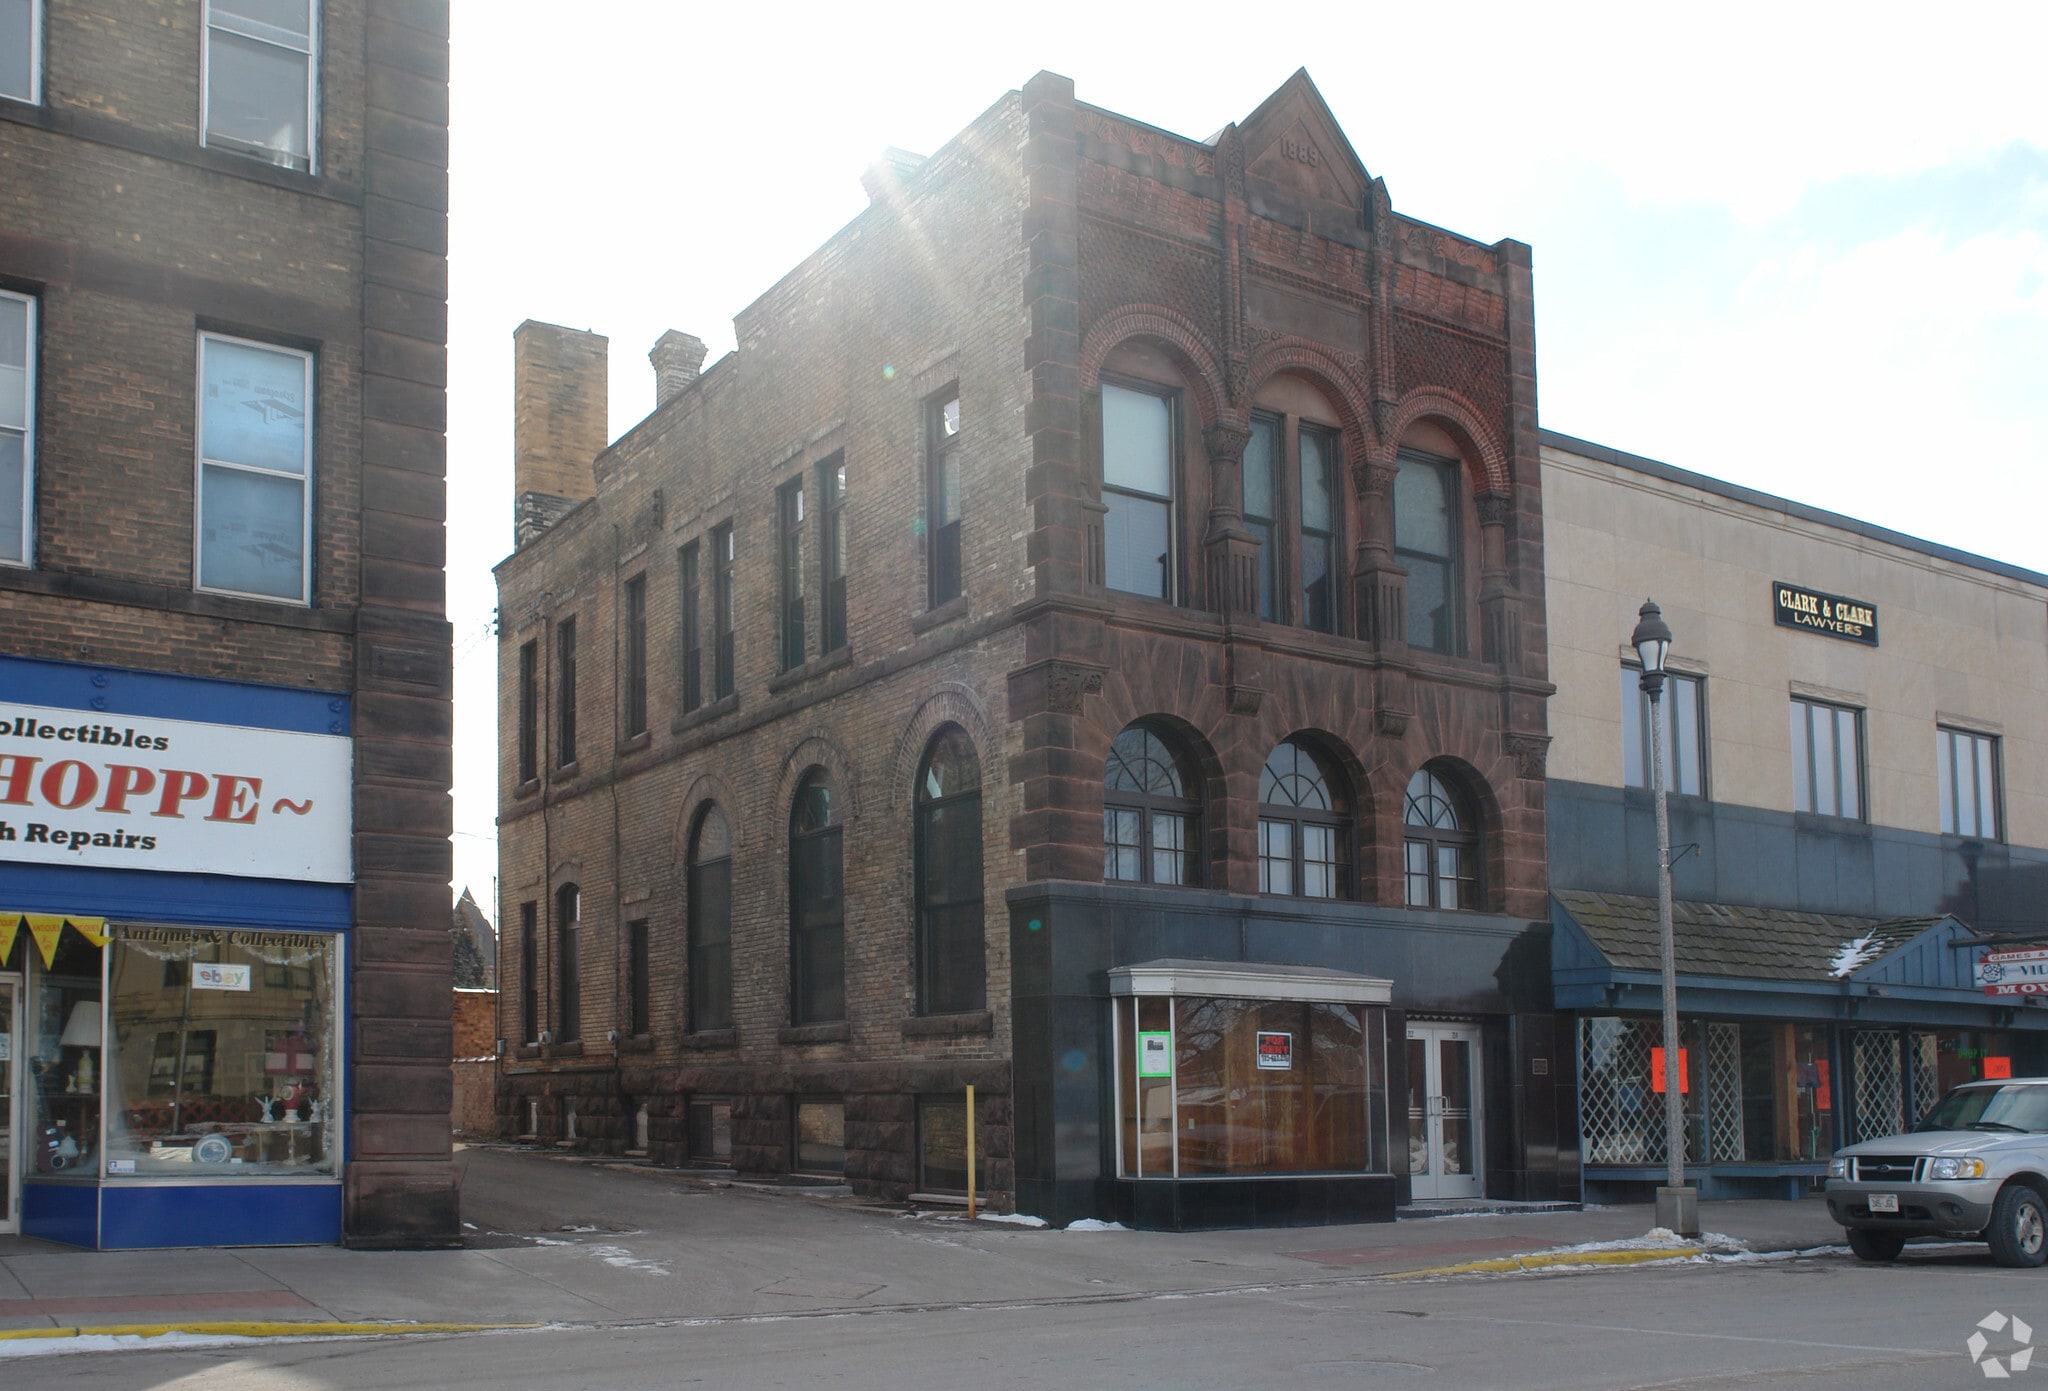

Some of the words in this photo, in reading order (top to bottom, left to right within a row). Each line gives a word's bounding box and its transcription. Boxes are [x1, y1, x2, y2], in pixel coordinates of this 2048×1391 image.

[1780, 589, 1818, 615] CLARK
[1822, 599, 1832, 618] &
[1836, 602, 1873, 628] CLARK
[1794, 611, 1862, 637] LAWYERS
[24, 822, 157, 851] Repairs
[121, 926, 200, 947] Antiques
[202, 930, 221, 945] &
[228, 930, 329, 950] Collectibles
[1991, 952, 2031, 961] GAMES
[200, 969, 245, 985] ebay
[1260, 1044, 1289, 1055] RENT
[1265, 1035, 1285, 1045] FOR
